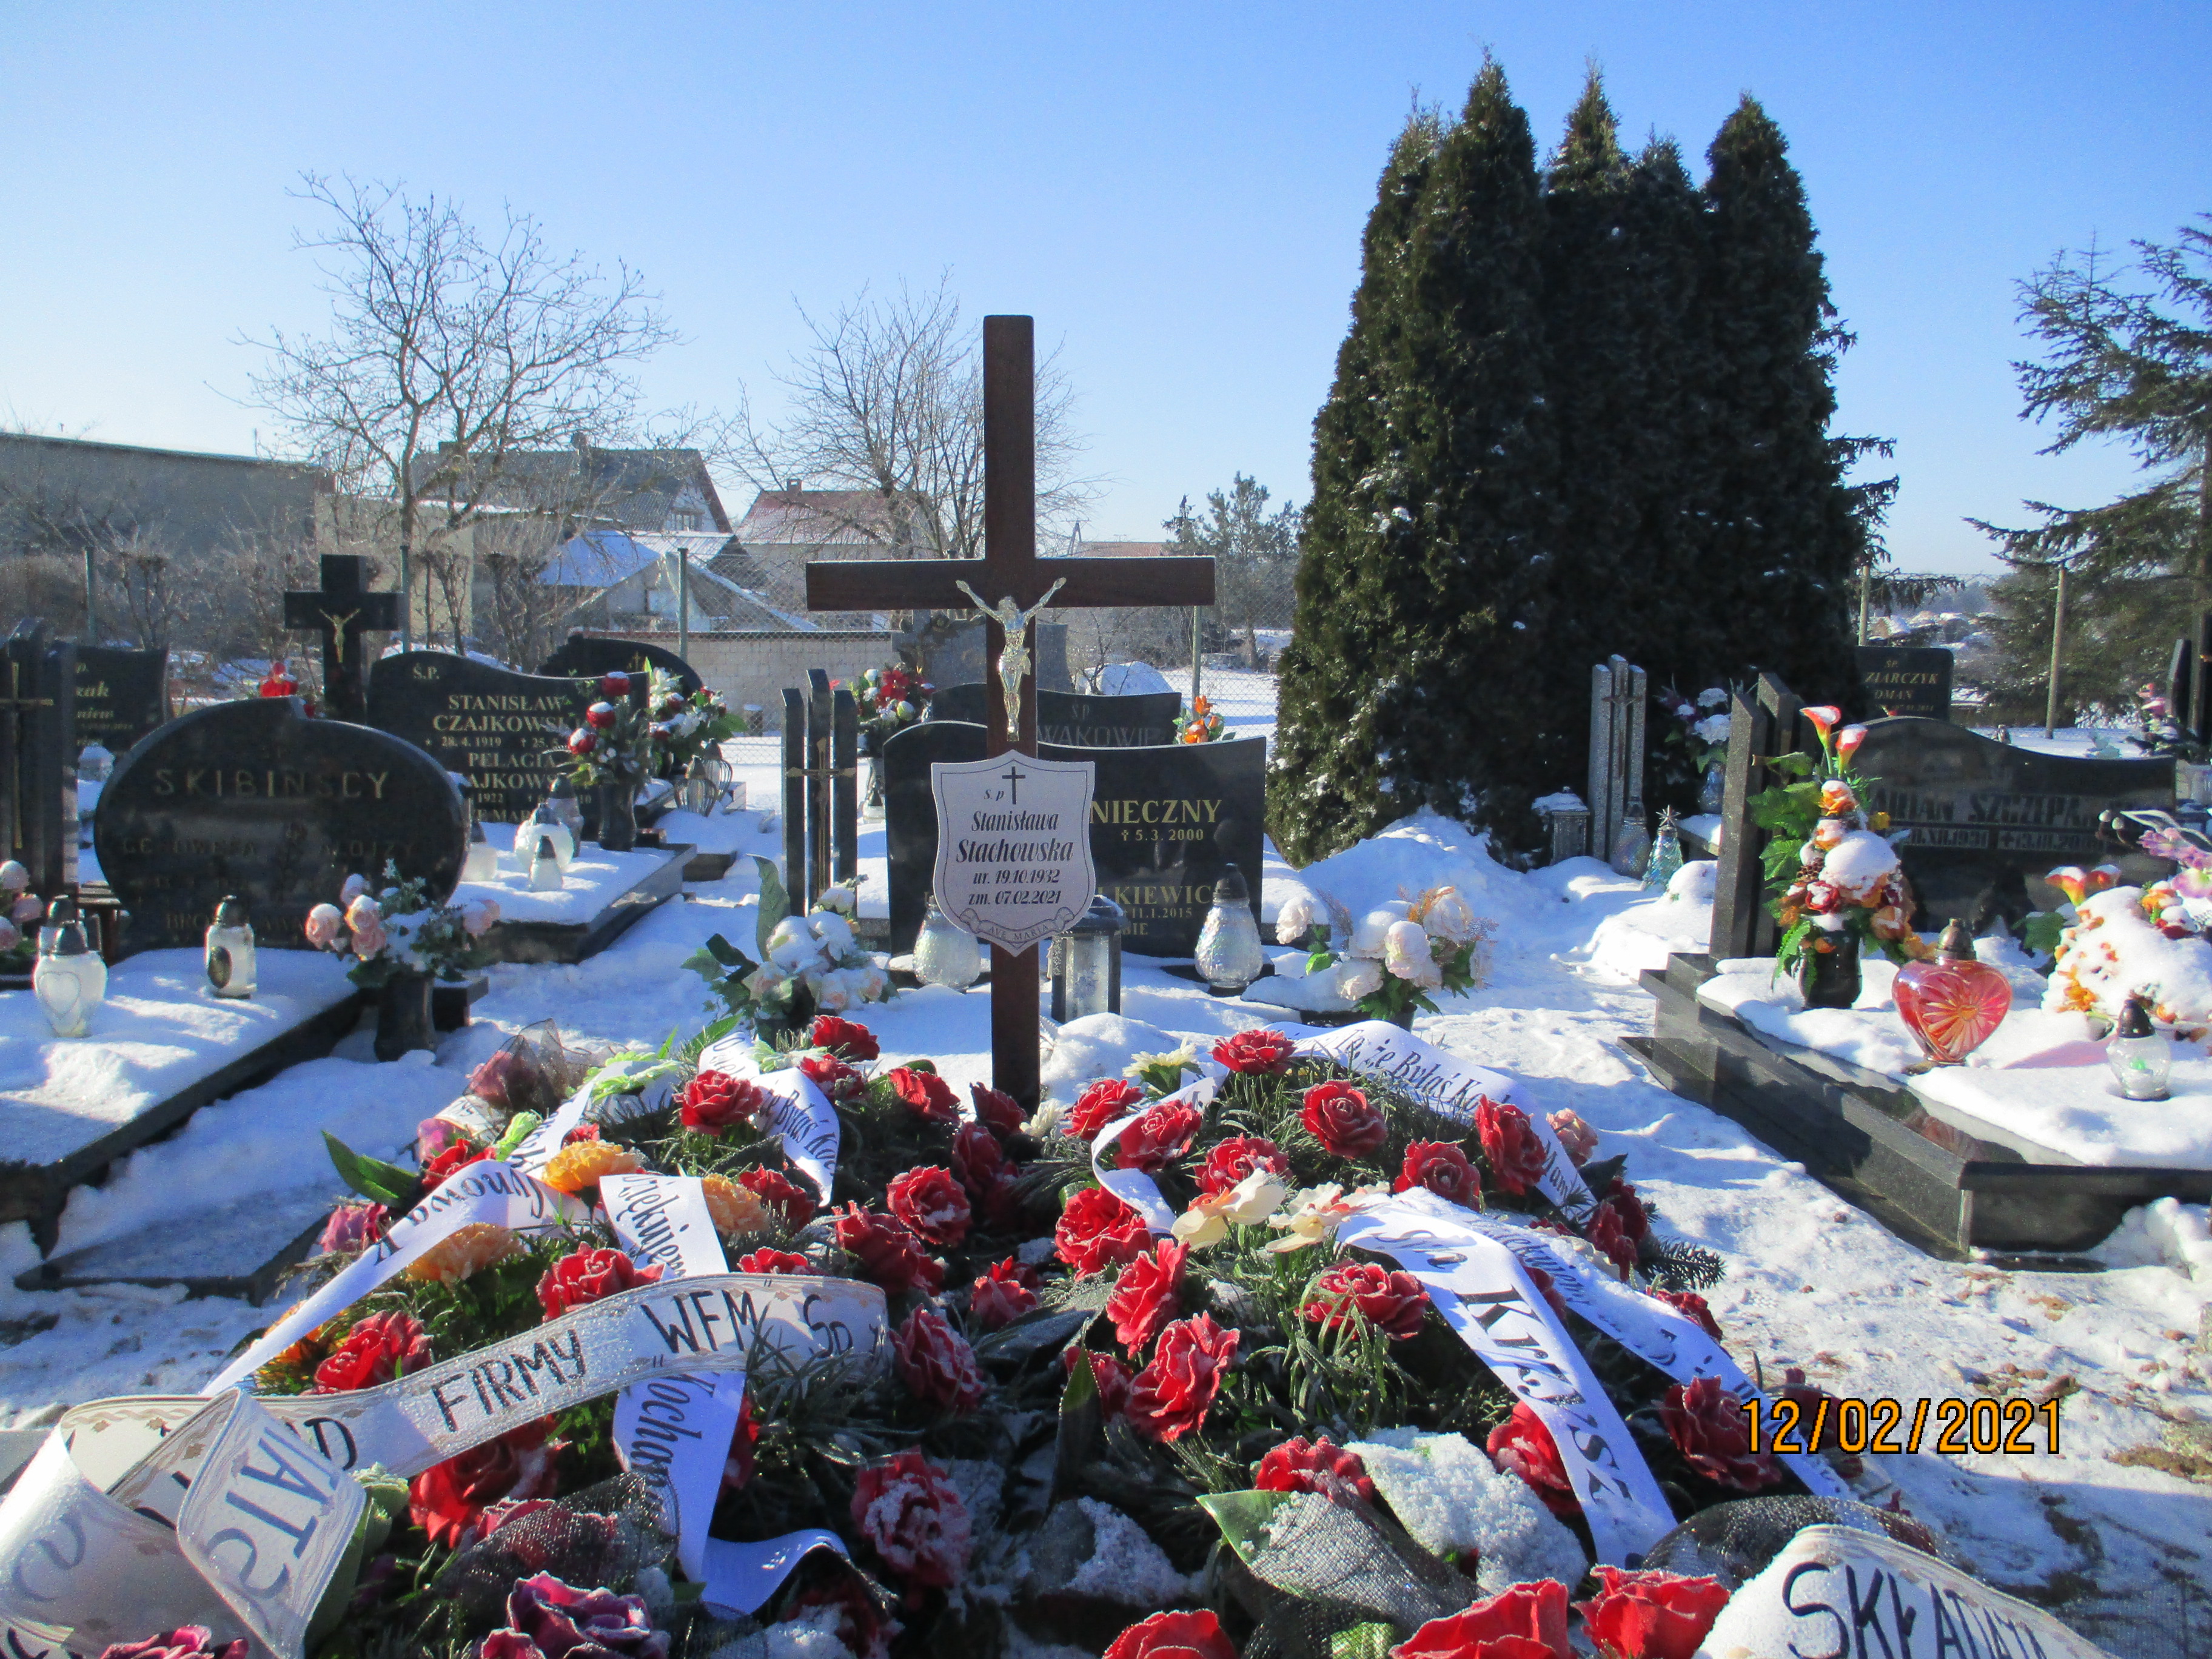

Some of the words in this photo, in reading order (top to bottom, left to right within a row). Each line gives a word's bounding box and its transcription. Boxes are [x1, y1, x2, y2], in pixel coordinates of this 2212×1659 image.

[1874, 689, 1914, 700] OMAN
[468, 752, 558, 768] PELAGIA
[971, 810, 1059, 832] Stanisława
[956, 837, 1073, 863] Stachowska
[973, 872, 990, 884] ur.
[995, 869, 1061, 884] 19.10.1932
[968, 893, 990, 905] zm.
[994, 890, 1061, 905] 07.02.2021
[988, 926, 1006, 939] AVE
[1013, 924, 1049, 940] MARIA
[430, 1329, 588, 1432] FIRMY
